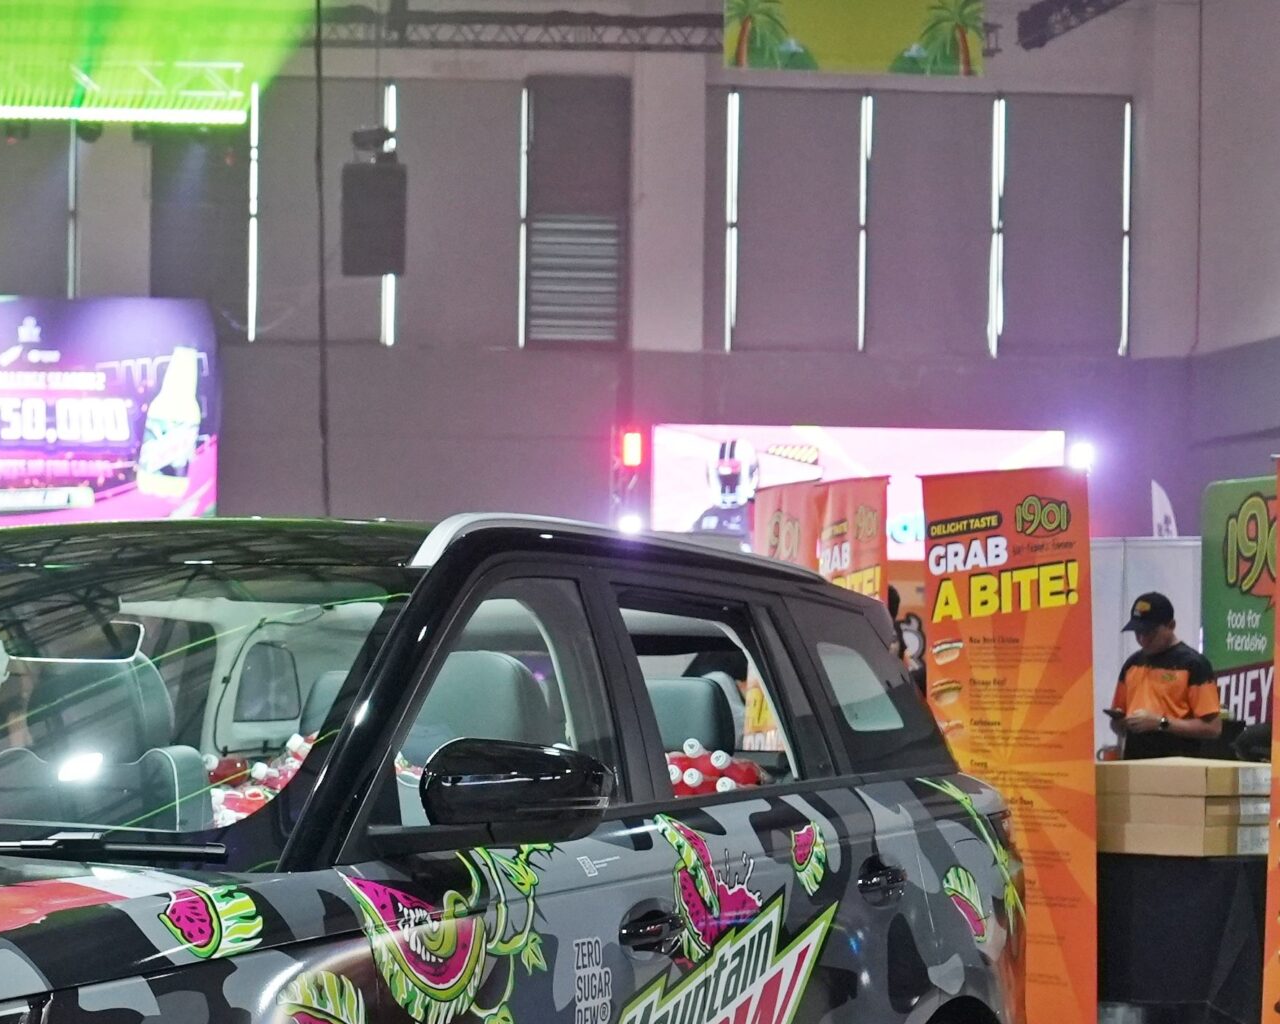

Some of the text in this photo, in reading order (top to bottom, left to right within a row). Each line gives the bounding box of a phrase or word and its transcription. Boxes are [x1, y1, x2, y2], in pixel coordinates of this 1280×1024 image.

[930, 515, 998, 536] DELIGHT TASTE
[1014, 494, 1070, 536] 1901
[928, 536, 1009, 576] GRAB
[931, 560, 1079, 624] A BITE!
[1227, 609, 1261, 629] food for
[1226, 632, 1267, 653] friendship
[1216, 666, 1274, 727] THEY
[575, 940, 601, 970] ZERO
[576, 971, 611, 1002] SUGAR
